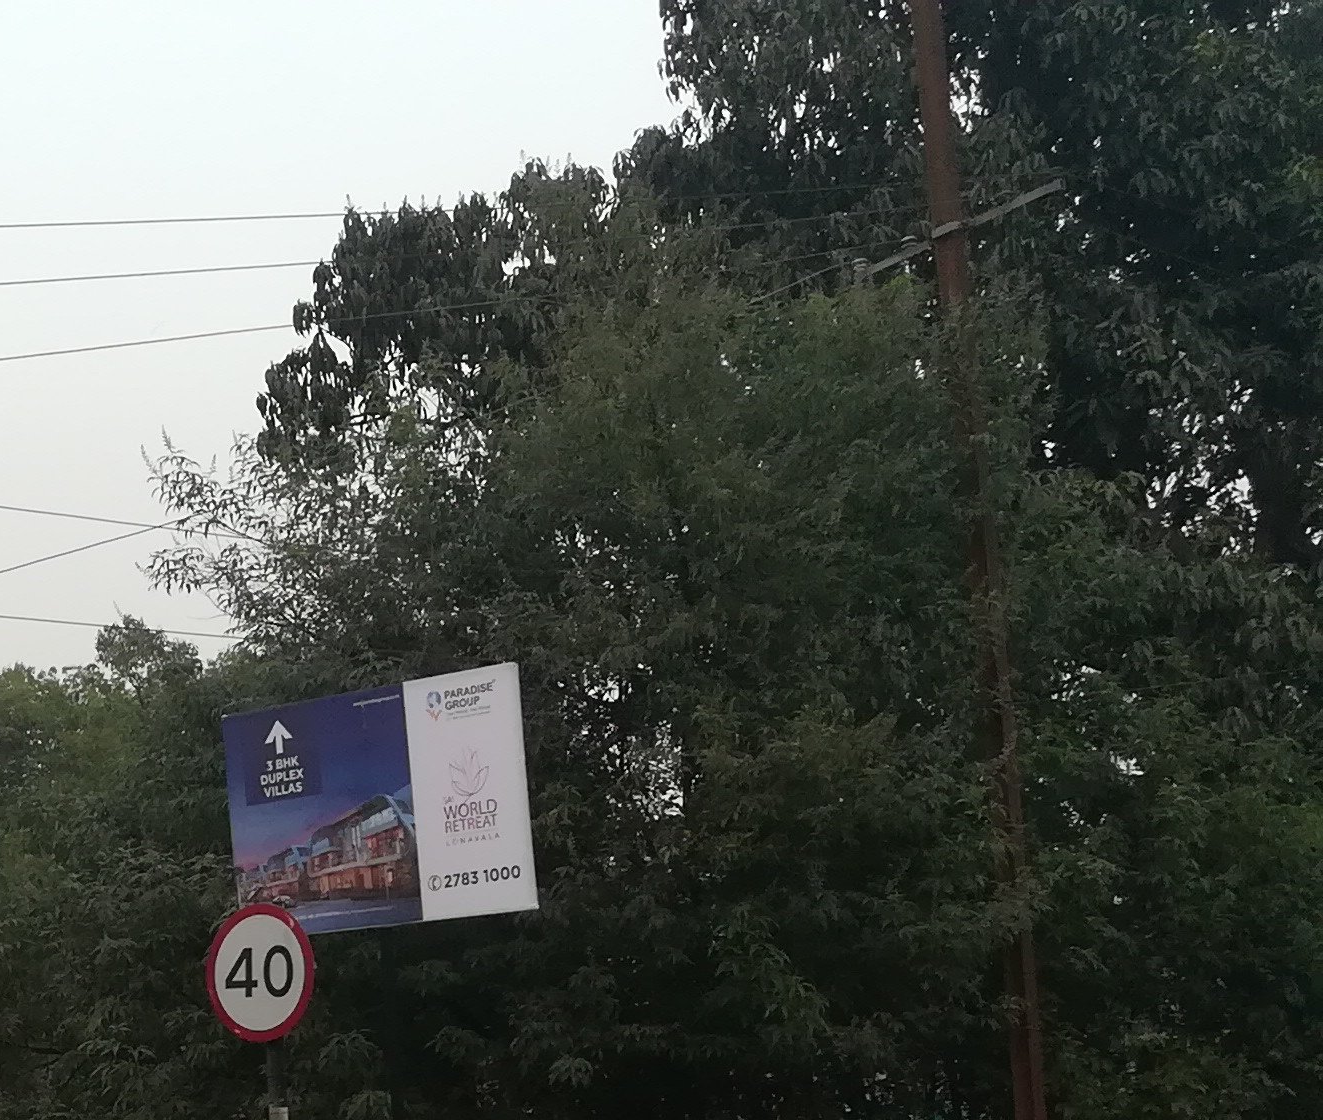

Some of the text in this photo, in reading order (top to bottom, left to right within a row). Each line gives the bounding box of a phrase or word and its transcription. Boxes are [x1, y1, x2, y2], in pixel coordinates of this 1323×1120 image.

[444, 682, 494, 699] PARADISE
[445, 695, 480, 710] GROUP
[266, 755, 300, 771] 3 BHK
[260, 768, 304, 786] DUPLEX
[263, 781, 303, 798] VILLAS
[443, 798, 498, 820] WORLD
[444, 813, 498, 834] RETREAT
[444, 864, 521, 889] 2783 1000
[224, 943, 294, 999] 40
